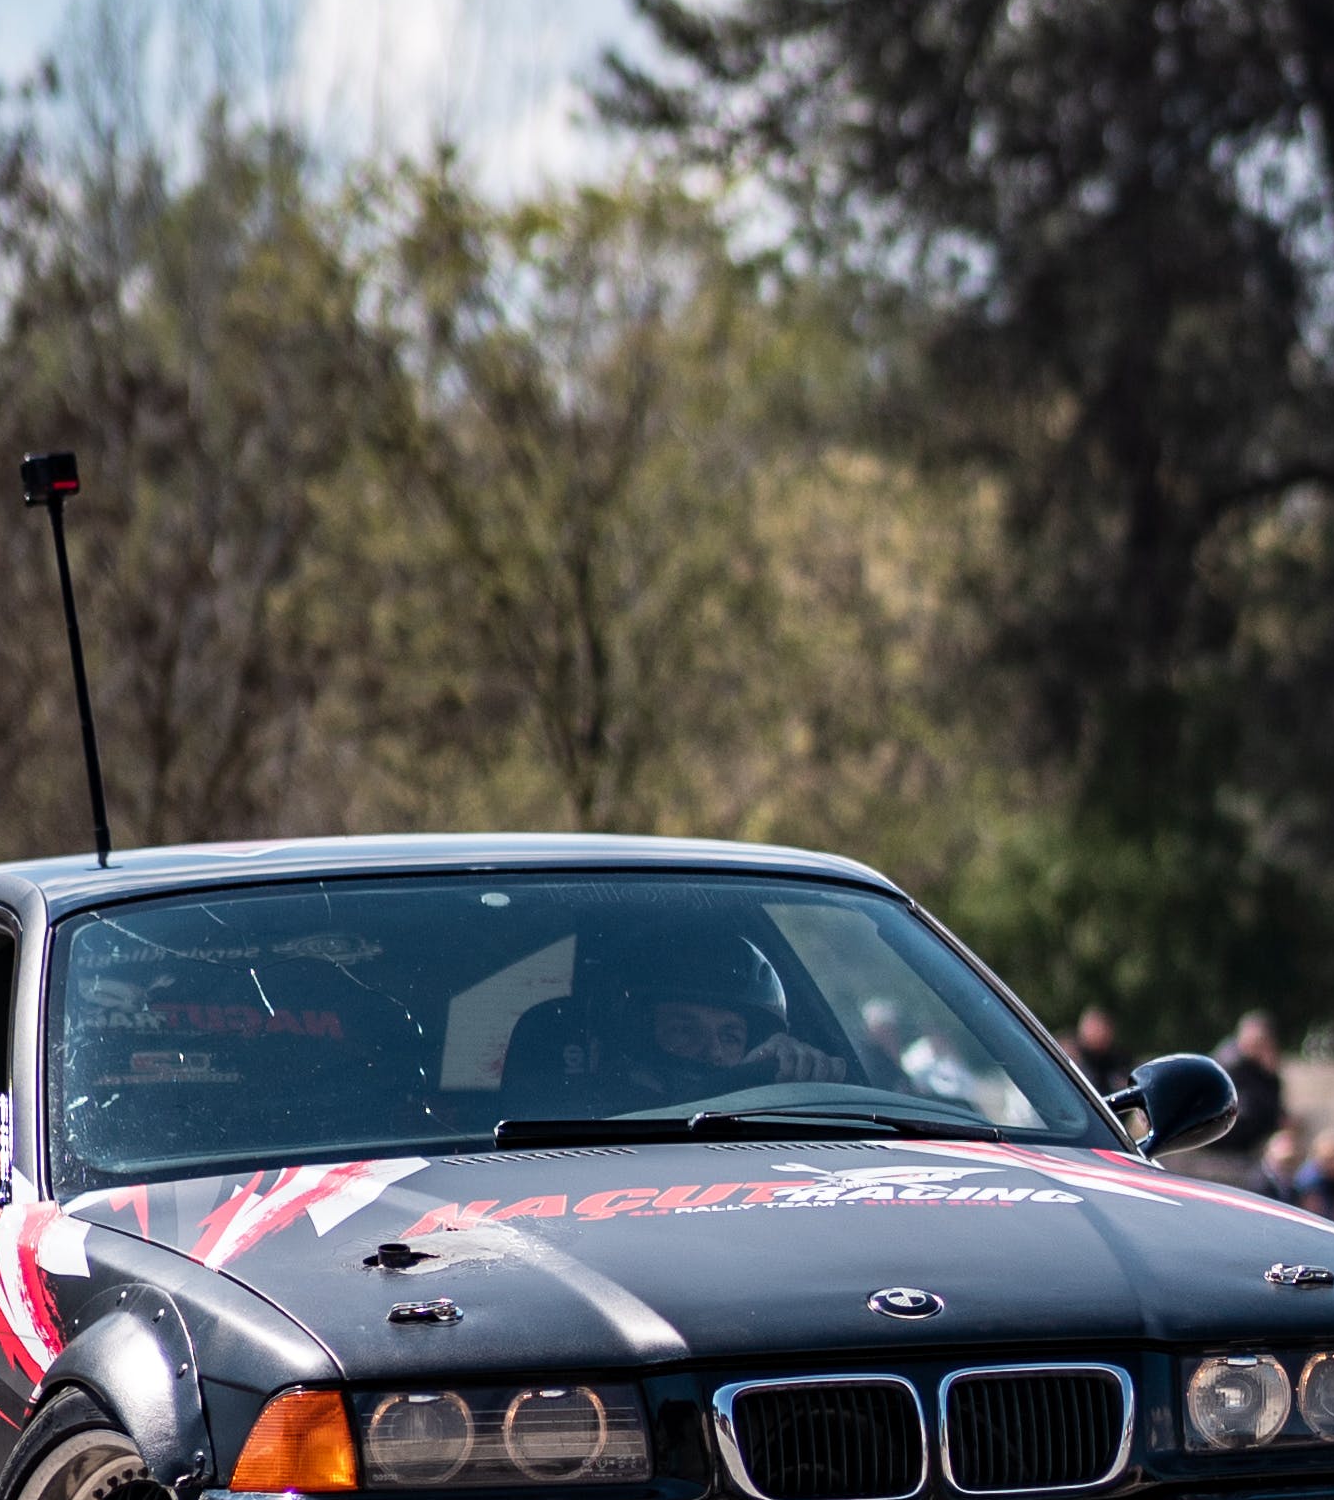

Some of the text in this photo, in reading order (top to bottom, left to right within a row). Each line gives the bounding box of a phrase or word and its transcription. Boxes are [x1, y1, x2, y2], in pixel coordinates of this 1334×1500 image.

[773, 1183, 1085, 1205] RACING
[674, 1203, 757, 1214] RALLY
[762, 1200, 836, 1209] TEAM
